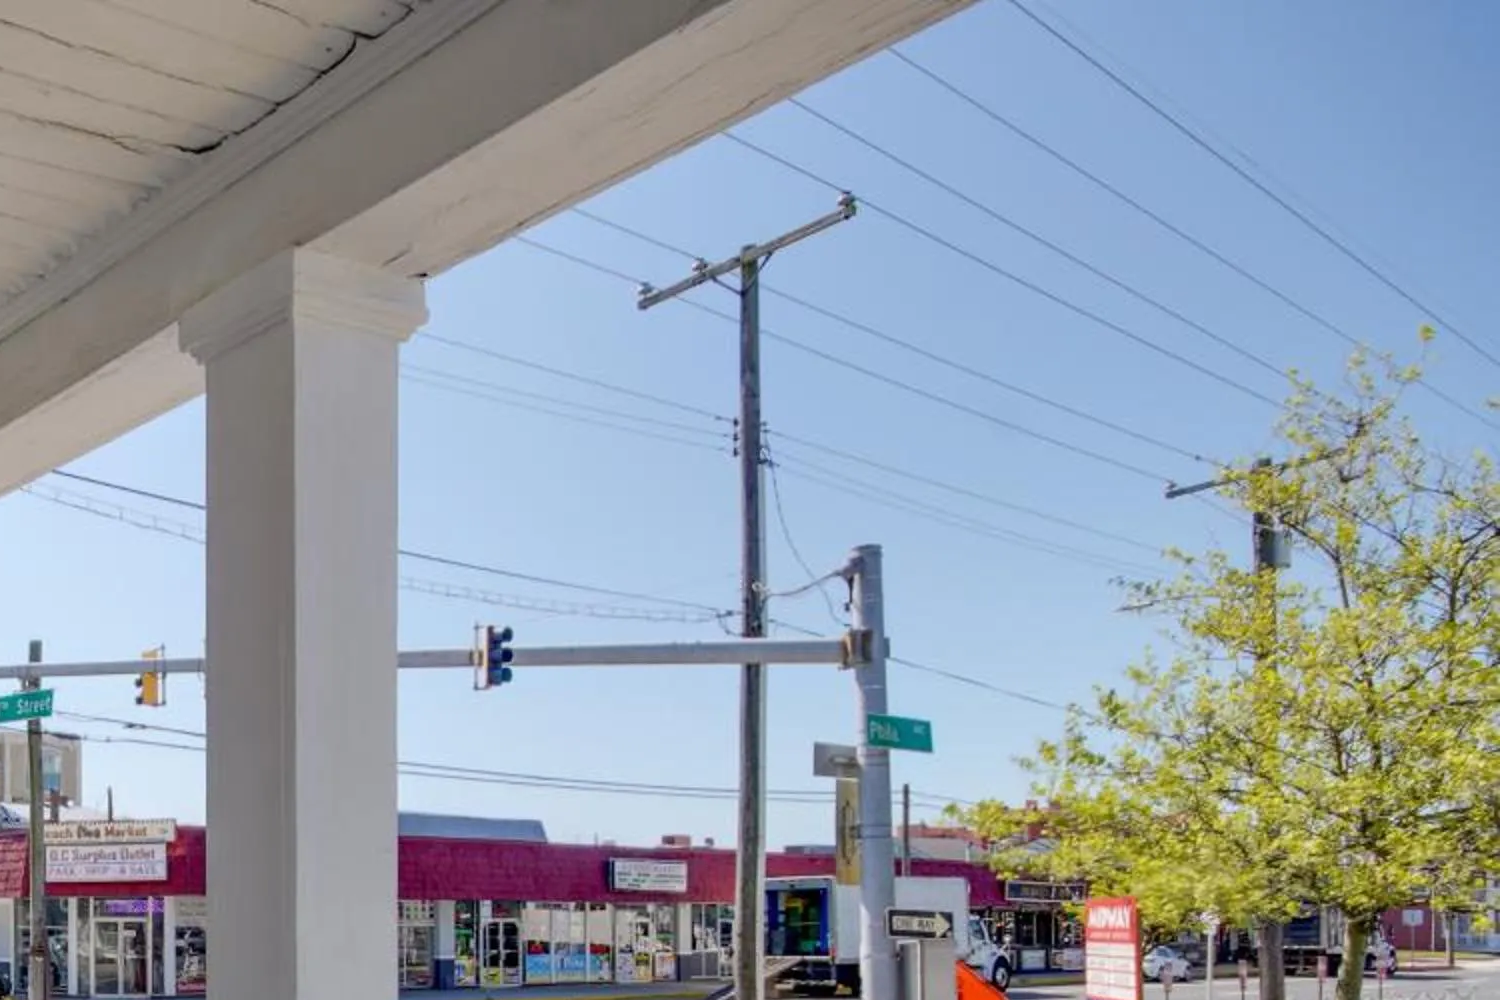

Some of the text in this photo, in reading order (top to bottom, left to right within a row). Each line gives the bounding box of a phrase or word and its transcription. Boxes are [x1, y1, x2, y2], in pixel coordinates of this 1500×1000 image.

[16, 696, 51, 715] Street
[104, 825, 148, 838] Market
[119, 847, 156, 861] Outlet
[1088, 904, 1131, 930] MIDWAY
